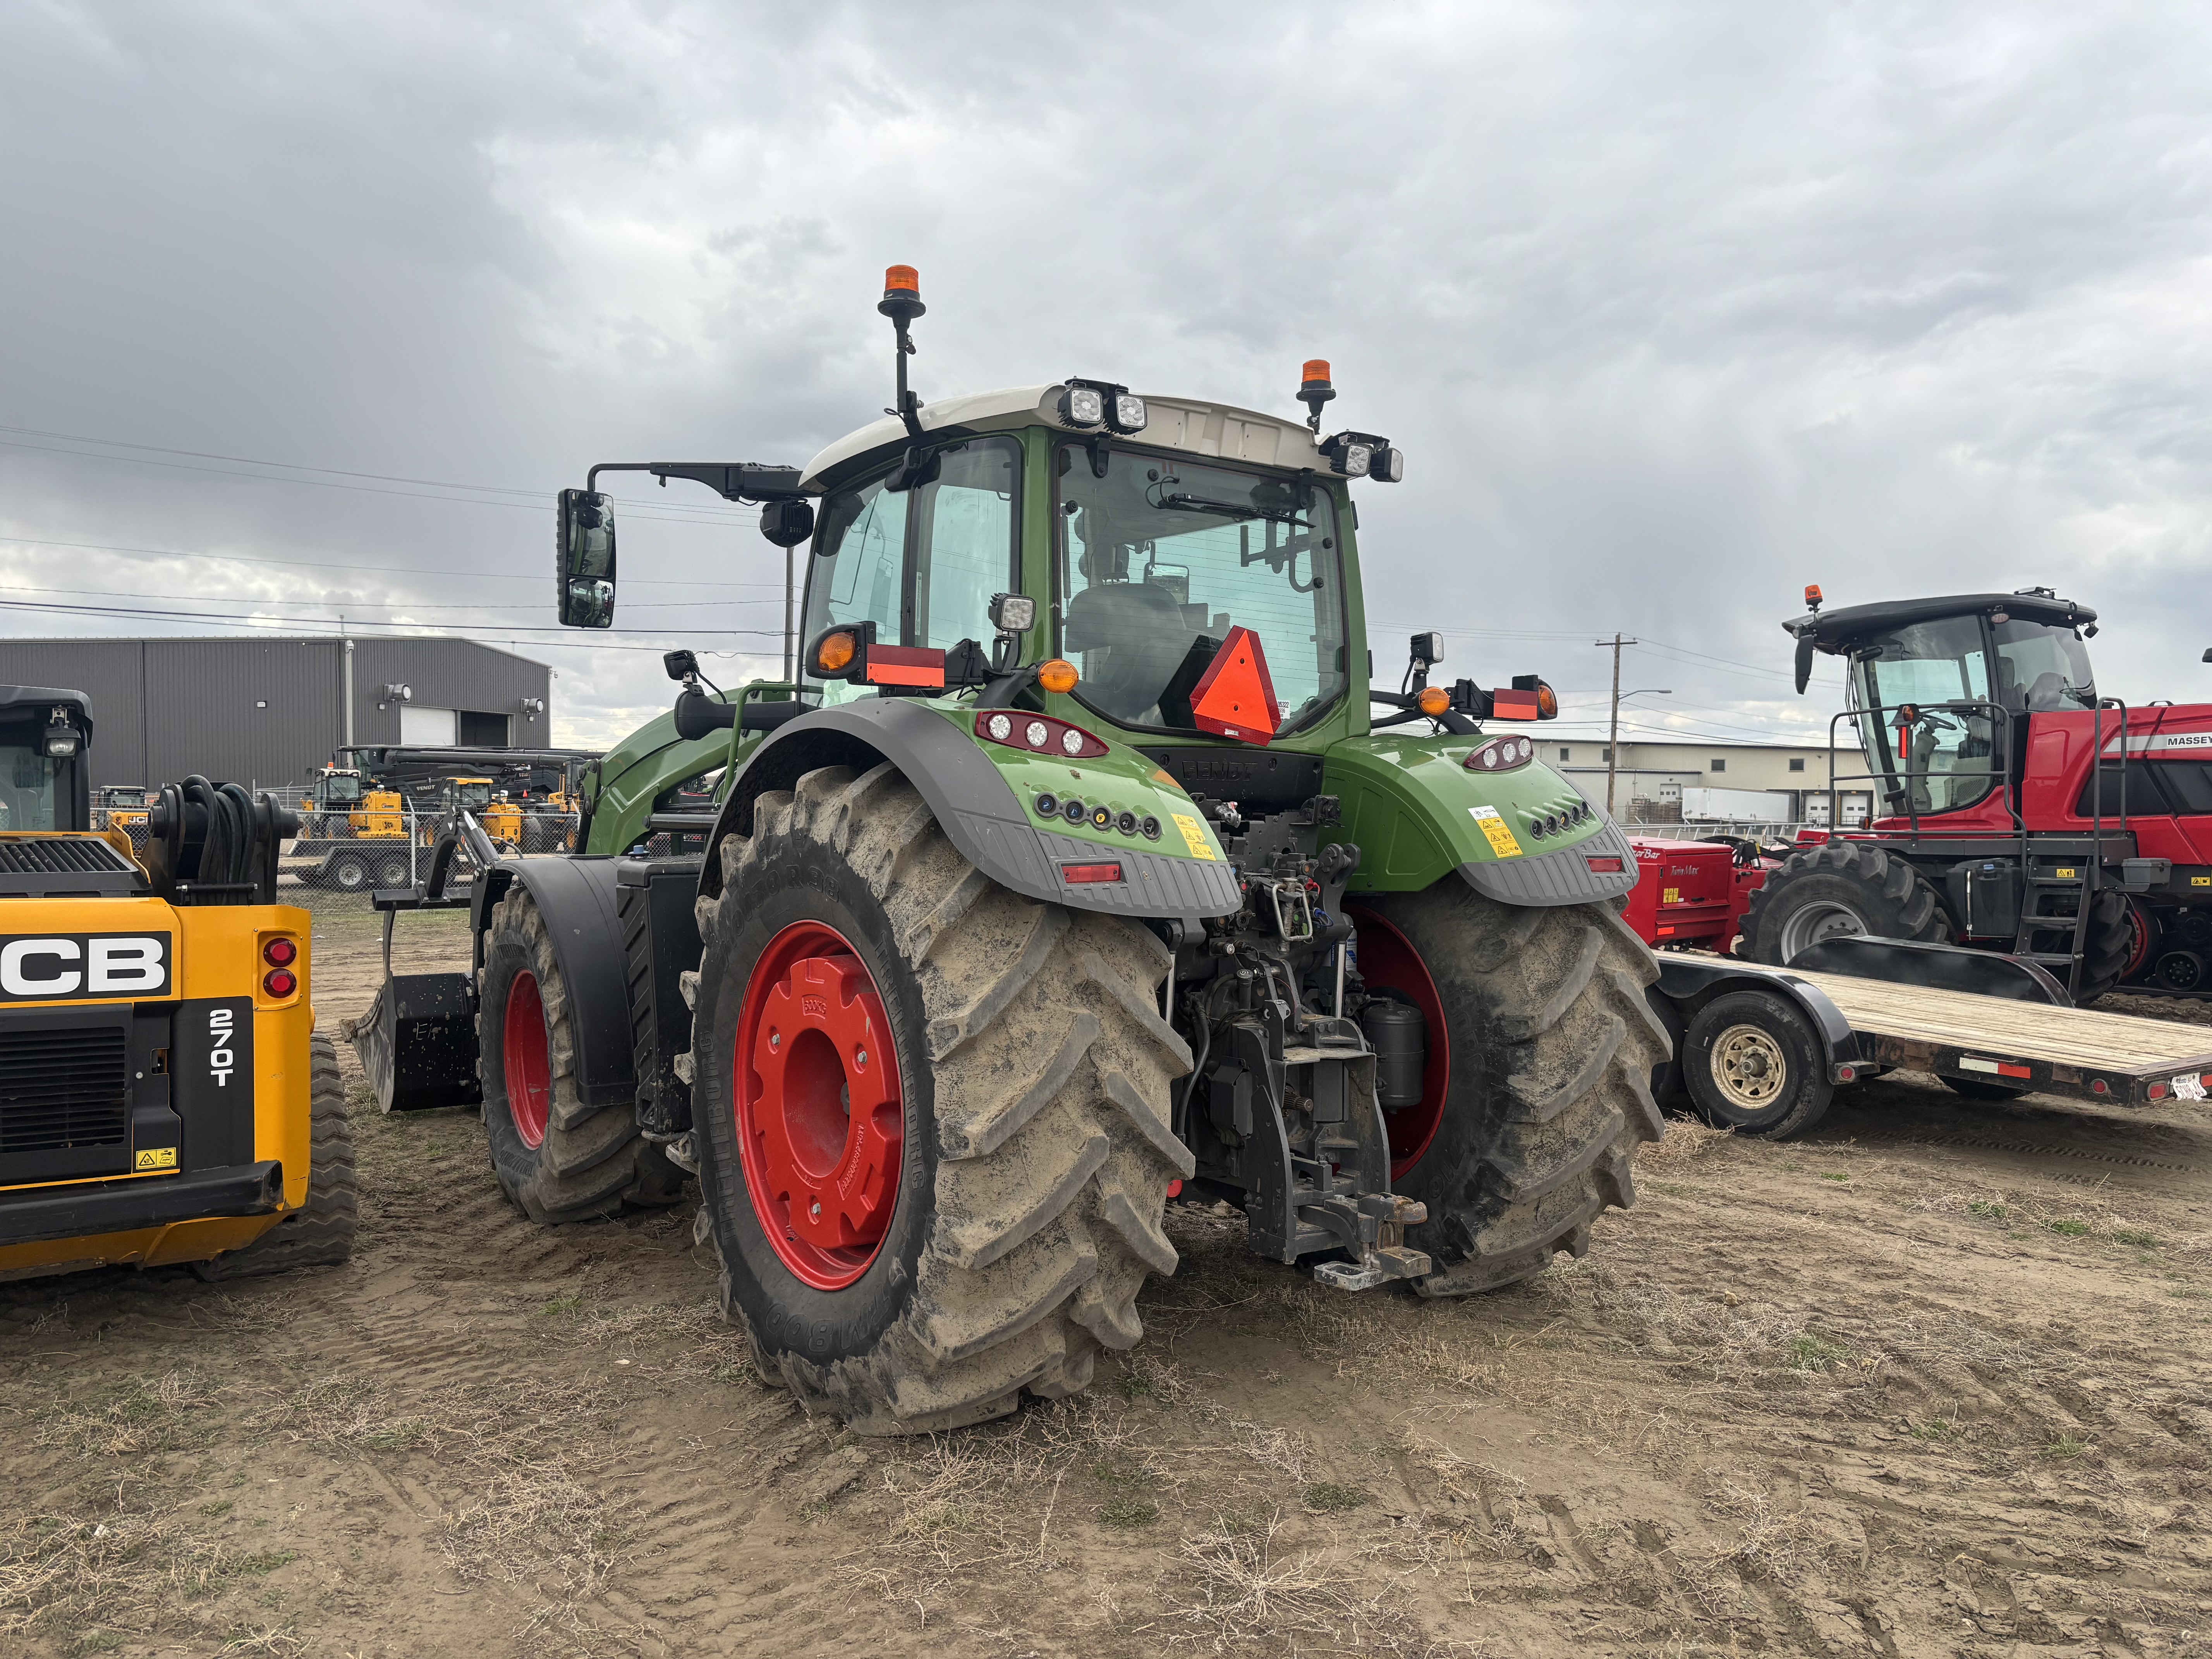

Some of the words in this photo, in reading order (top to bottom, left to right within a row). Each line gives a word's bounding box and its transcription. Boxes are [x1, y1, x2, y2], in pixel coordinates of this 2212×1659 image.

[1182, 760, 1258, 781] FENDT
[805, 1000, 826, 1013] 600KG
[210, 1009, 234, 1087] 270T
[874, 930, 926, 1190] TRELLEBORG
[699, 1031, 738, 1246] TRELLEBORG
[765, 1284, 891, 1353] TM800
